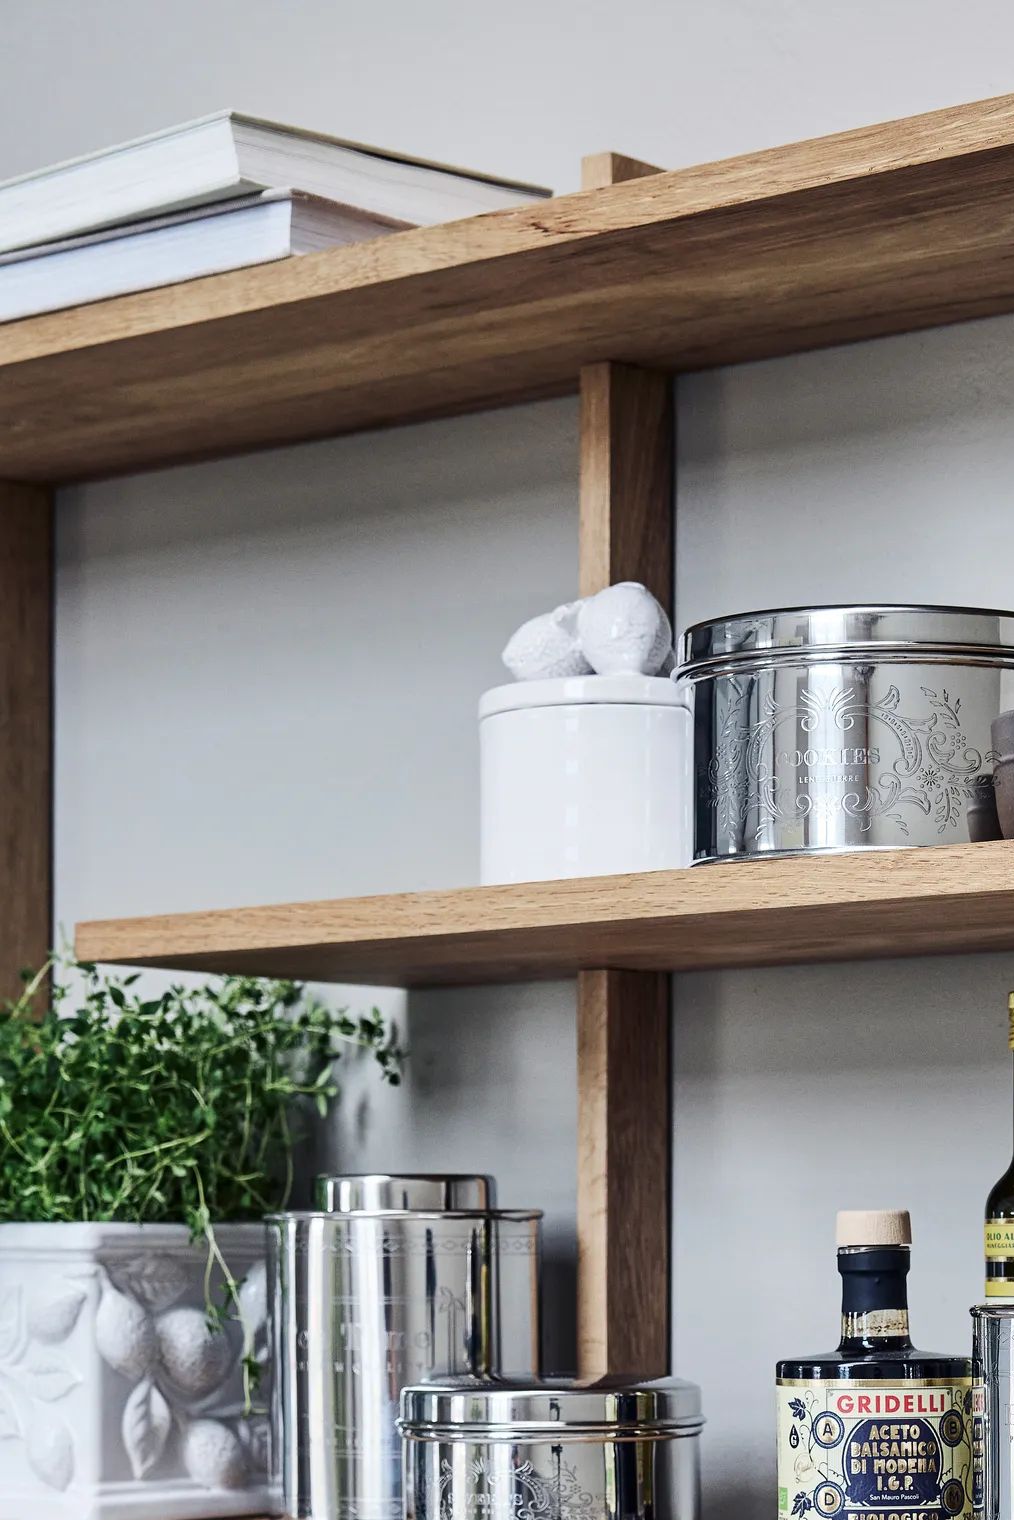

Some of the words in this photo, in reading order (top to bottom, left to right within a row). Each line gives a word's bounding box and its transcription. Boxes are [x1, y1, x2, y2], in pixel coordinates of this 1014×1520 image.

[775, 747, 880, 768] COOKIES
[837, 1393, 945, 1414] GRIDELLI
[822, 1422, 834, 1436] A
[868, 1424, 921, 1440] ACETO
[949, 1421, 958, 1434] B
[850, 1441, 938, 1458] BALSAMICO
[850, 1458, 868, 1475] DI
[873, 1457, 937, 1474] MODENA
[824, 1492, 835, 1506] D
